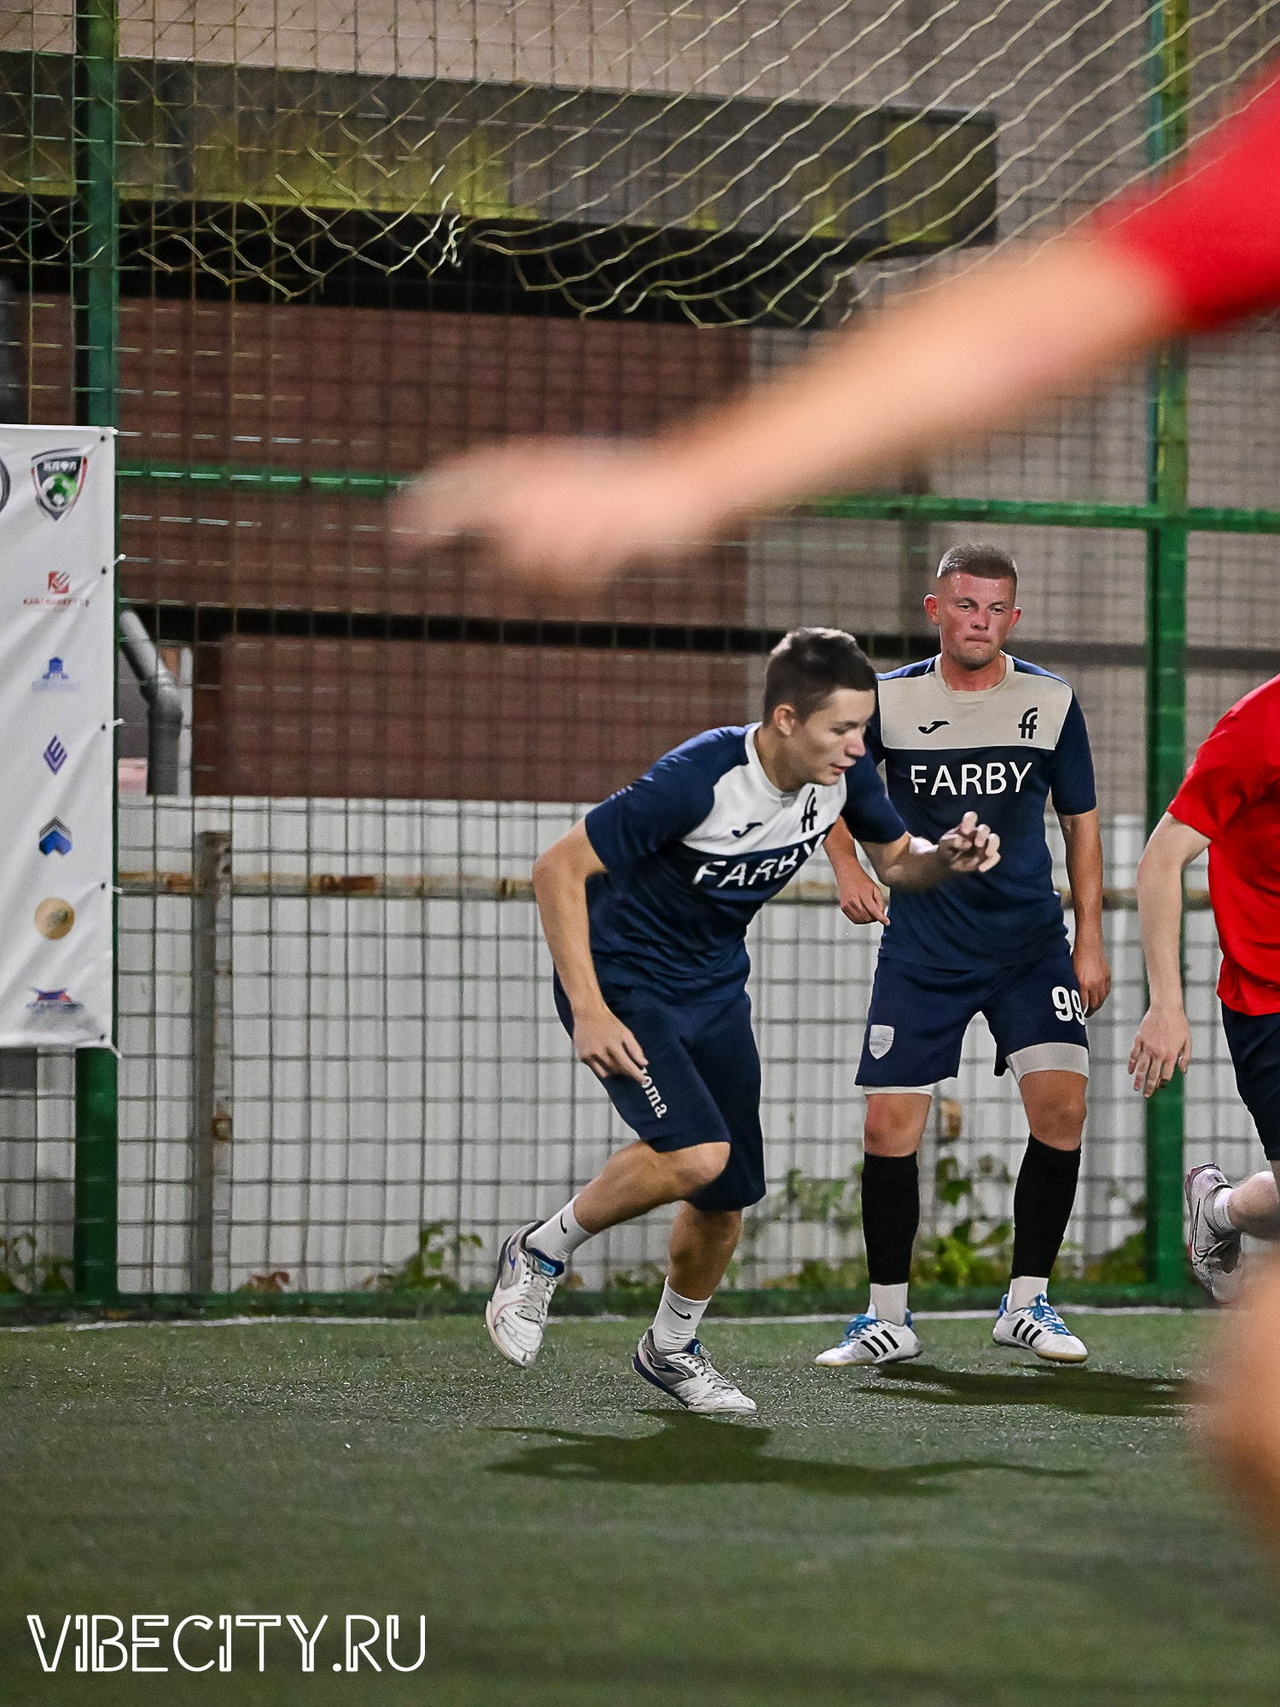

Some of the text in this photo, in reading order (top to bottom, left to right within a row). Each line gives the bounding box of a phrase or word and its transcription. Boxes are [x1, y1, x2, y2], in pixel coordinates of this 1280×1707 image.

[910, 761, 1033, 796] FARBY
[693, 834, 826, 888] FARBY
[1051, 986, 1086, 1026] 99
